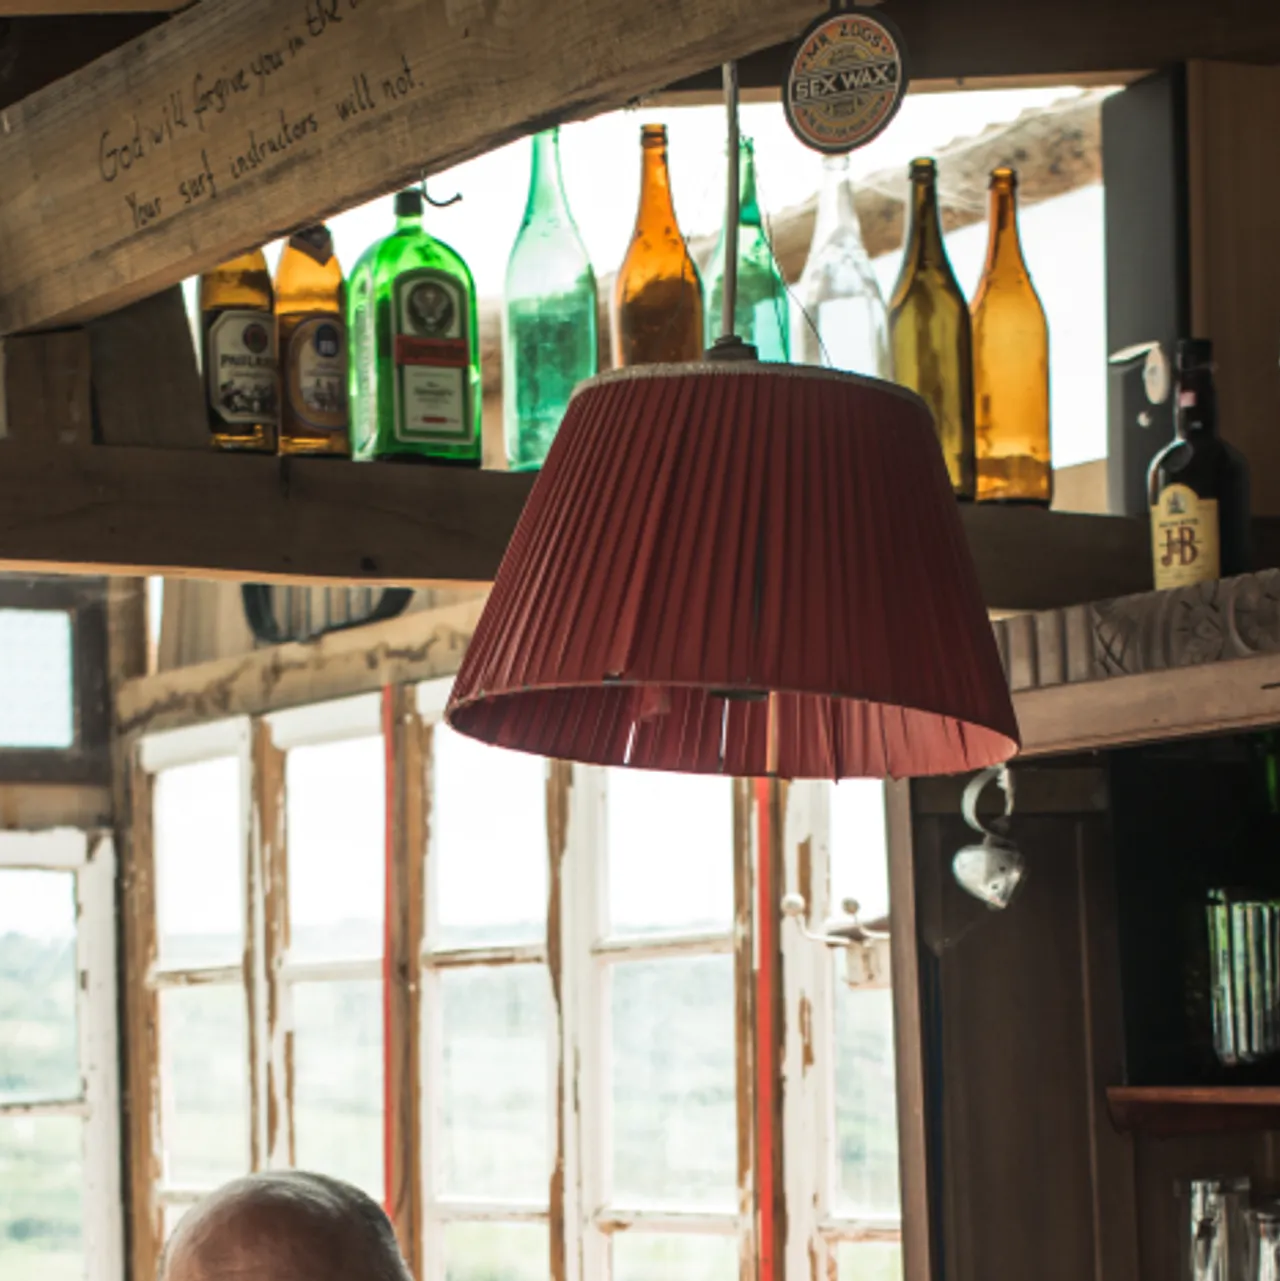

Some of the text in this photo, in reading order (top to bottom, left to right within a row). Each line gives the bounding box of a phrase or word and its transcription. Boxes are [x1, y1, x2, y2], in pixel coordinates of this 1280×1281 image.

[100, 0, 343, 182] God will forgive you in the
[124, 53, 425, 229] Your surf instructors will not.
[795, 63, 890, 101] SEX WAX
